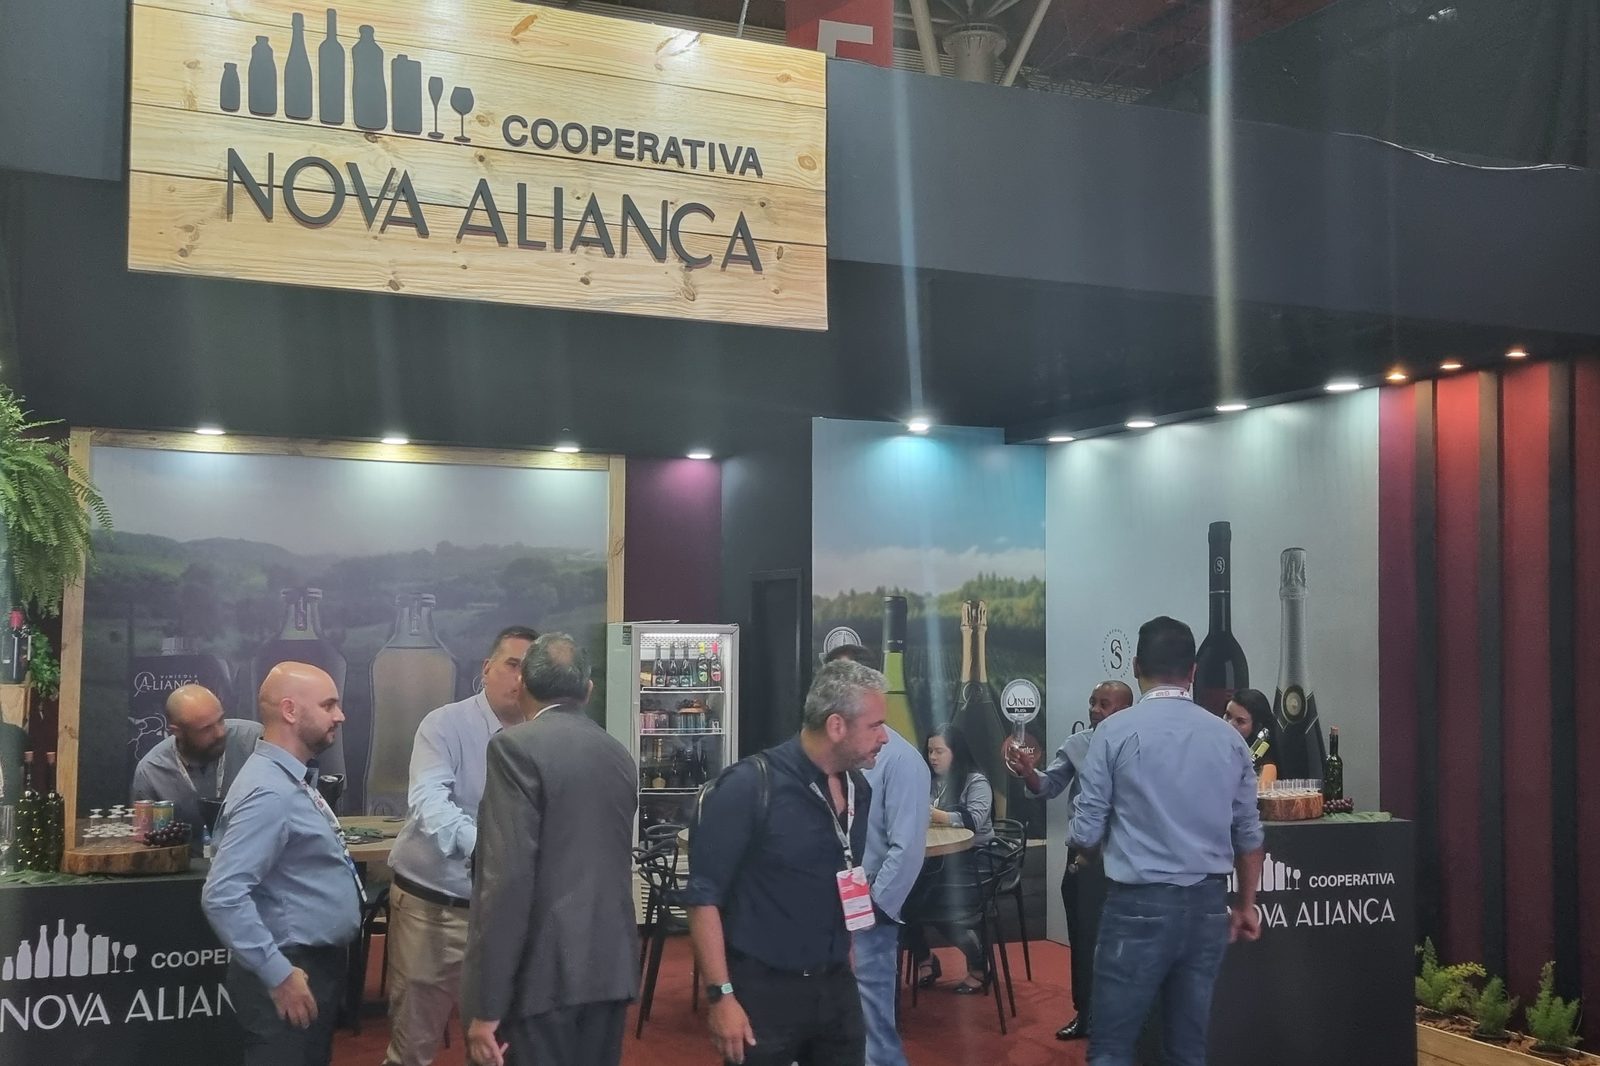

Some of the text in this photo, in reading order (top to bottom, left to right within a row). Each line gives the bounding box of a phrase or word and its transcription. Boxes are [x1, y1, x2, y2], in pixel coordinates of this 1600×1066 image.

[502, 114, 763, 178] COOPERATIVA
[226, 147, 430, 238] NOVA
[1308, 872, 1396, 888] COOPERATIVA
[1295, 897, 1396, 927] ALIANÇA
[0, 992, 111, 1033] NOVA
